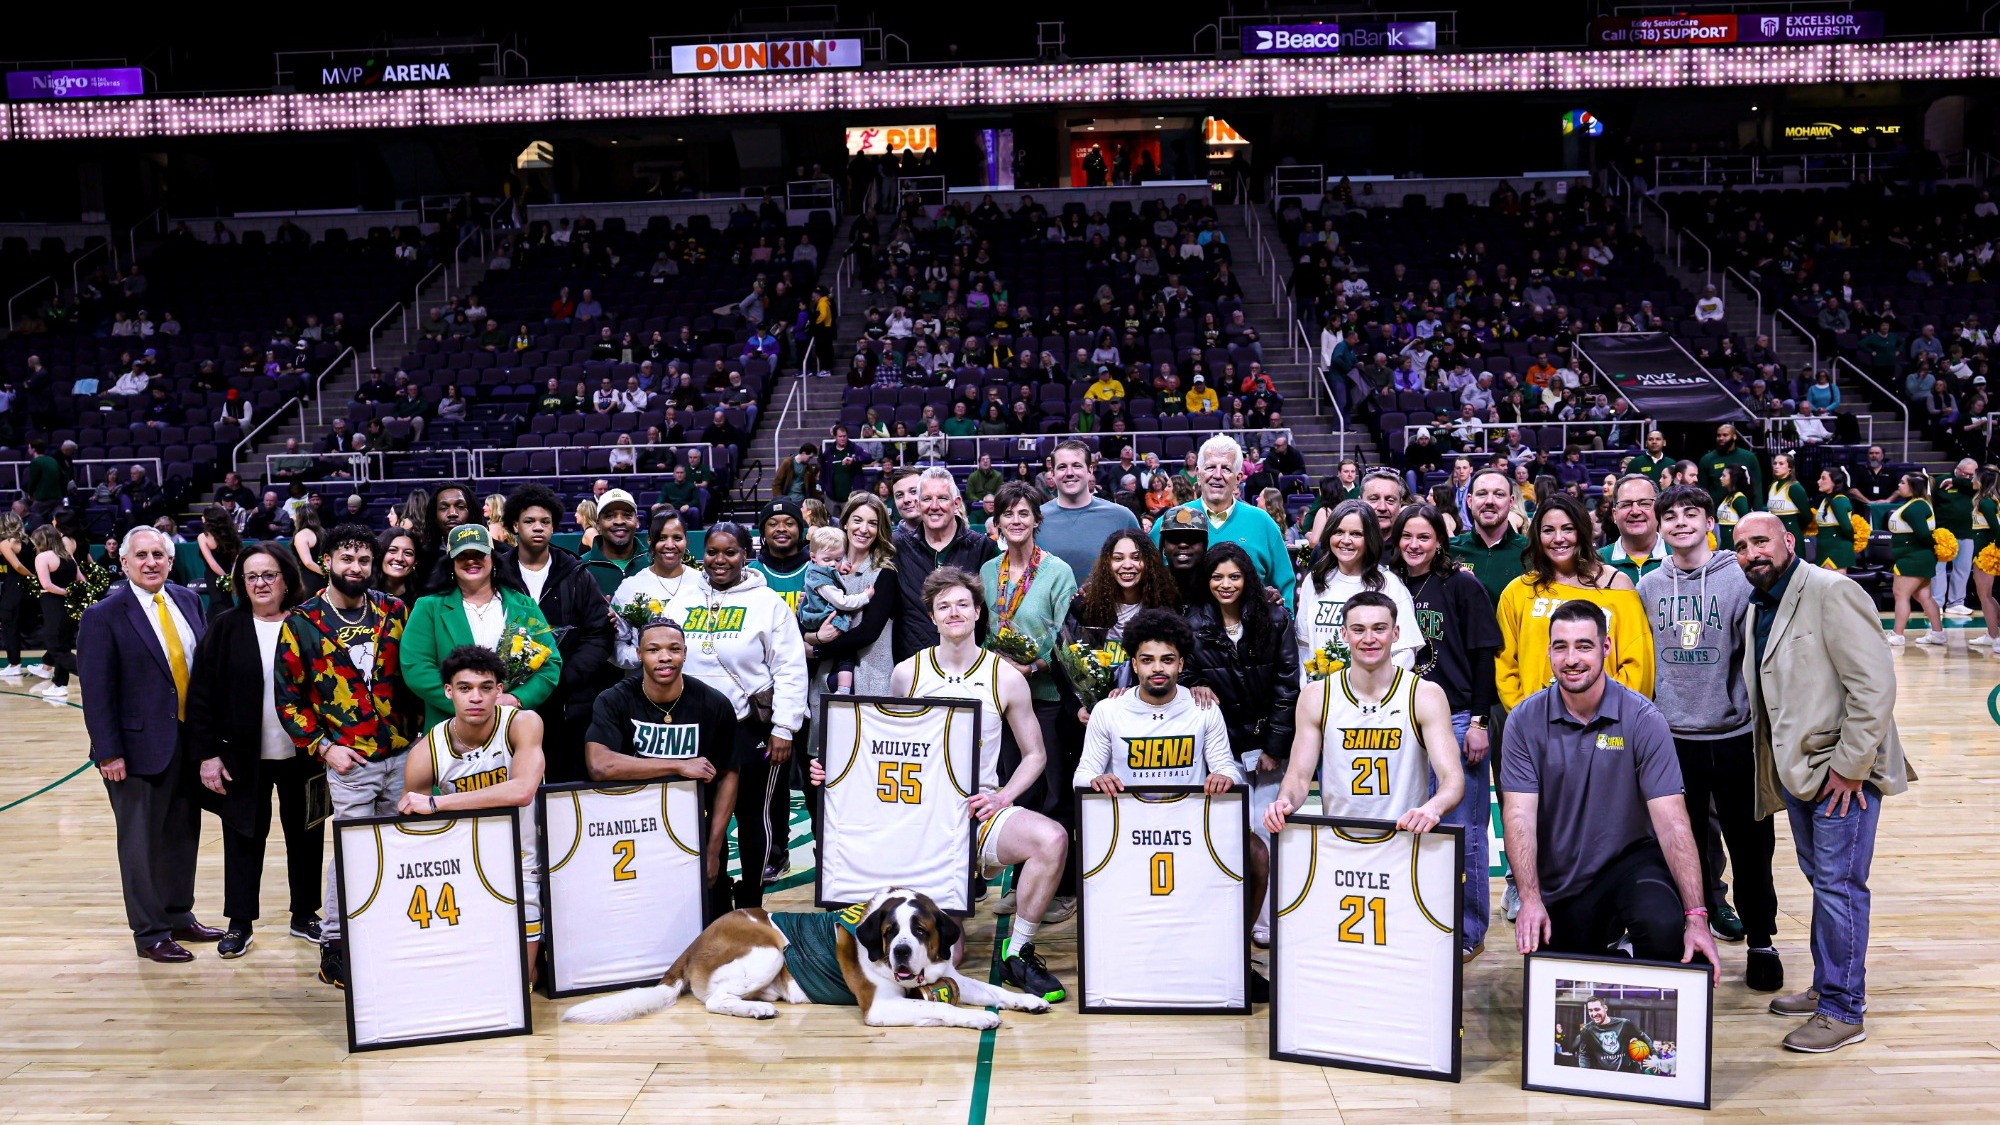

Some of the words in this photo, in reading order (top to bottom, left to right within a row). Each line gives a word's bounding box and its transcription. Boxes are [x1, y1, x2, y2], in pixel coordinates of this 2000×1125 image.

[1786, 15, 1854, 26] EXCELSIOR
[1786, 25, 1861, 36] UNIVERSITY
[1275, 27, 1403, 49] BeaconBank
[1602, 29, 1625, 40] Call
[1629, 29, 1660, 42] (518)
[1663, 26, 1728, 39] SUPPORT
[695, 41, 837, 71] DUNKIN'
[32, 74, 88, 95] Nigro
[322, 67, 363, 85] MVP
[382, 63, 451, 82] ARENA
[1785, 126, 1834, 137] MOHAWK
[1636, 373, 1676, 381] MVP
[1642, 377, 1710, 386] ARENA
[1658, 594, 1723, 631] SIENA
[1673, 650, 1709, 662] SAINTS
[634, 724, 696, 755] SIENA
[871, 740, 931, 758] MULVEY
[1343, 728, 1402, 750] SAINTS
[1130, 738, 1193, 767] SIENA
[454, 766, 508, 793] SAINTS
[876, 760, 923, 804] 55
[1132, 769, 1190, 777] BASKETBALL
[1352, 757, 1391, 795] 21
[588, 817, 657, 837] CHANDLER
[1132, 830, 1192, 845] SHOATS
[397, 859, 461, 879] JACKSON
[612, 839, 637, 881] 2
[1150, 852, 1175, 896] 0
[1335, 869, 1390, 890] COYLE
[406, 882, 461, 929] 44
[1338, 895, 1387, 946] 21
